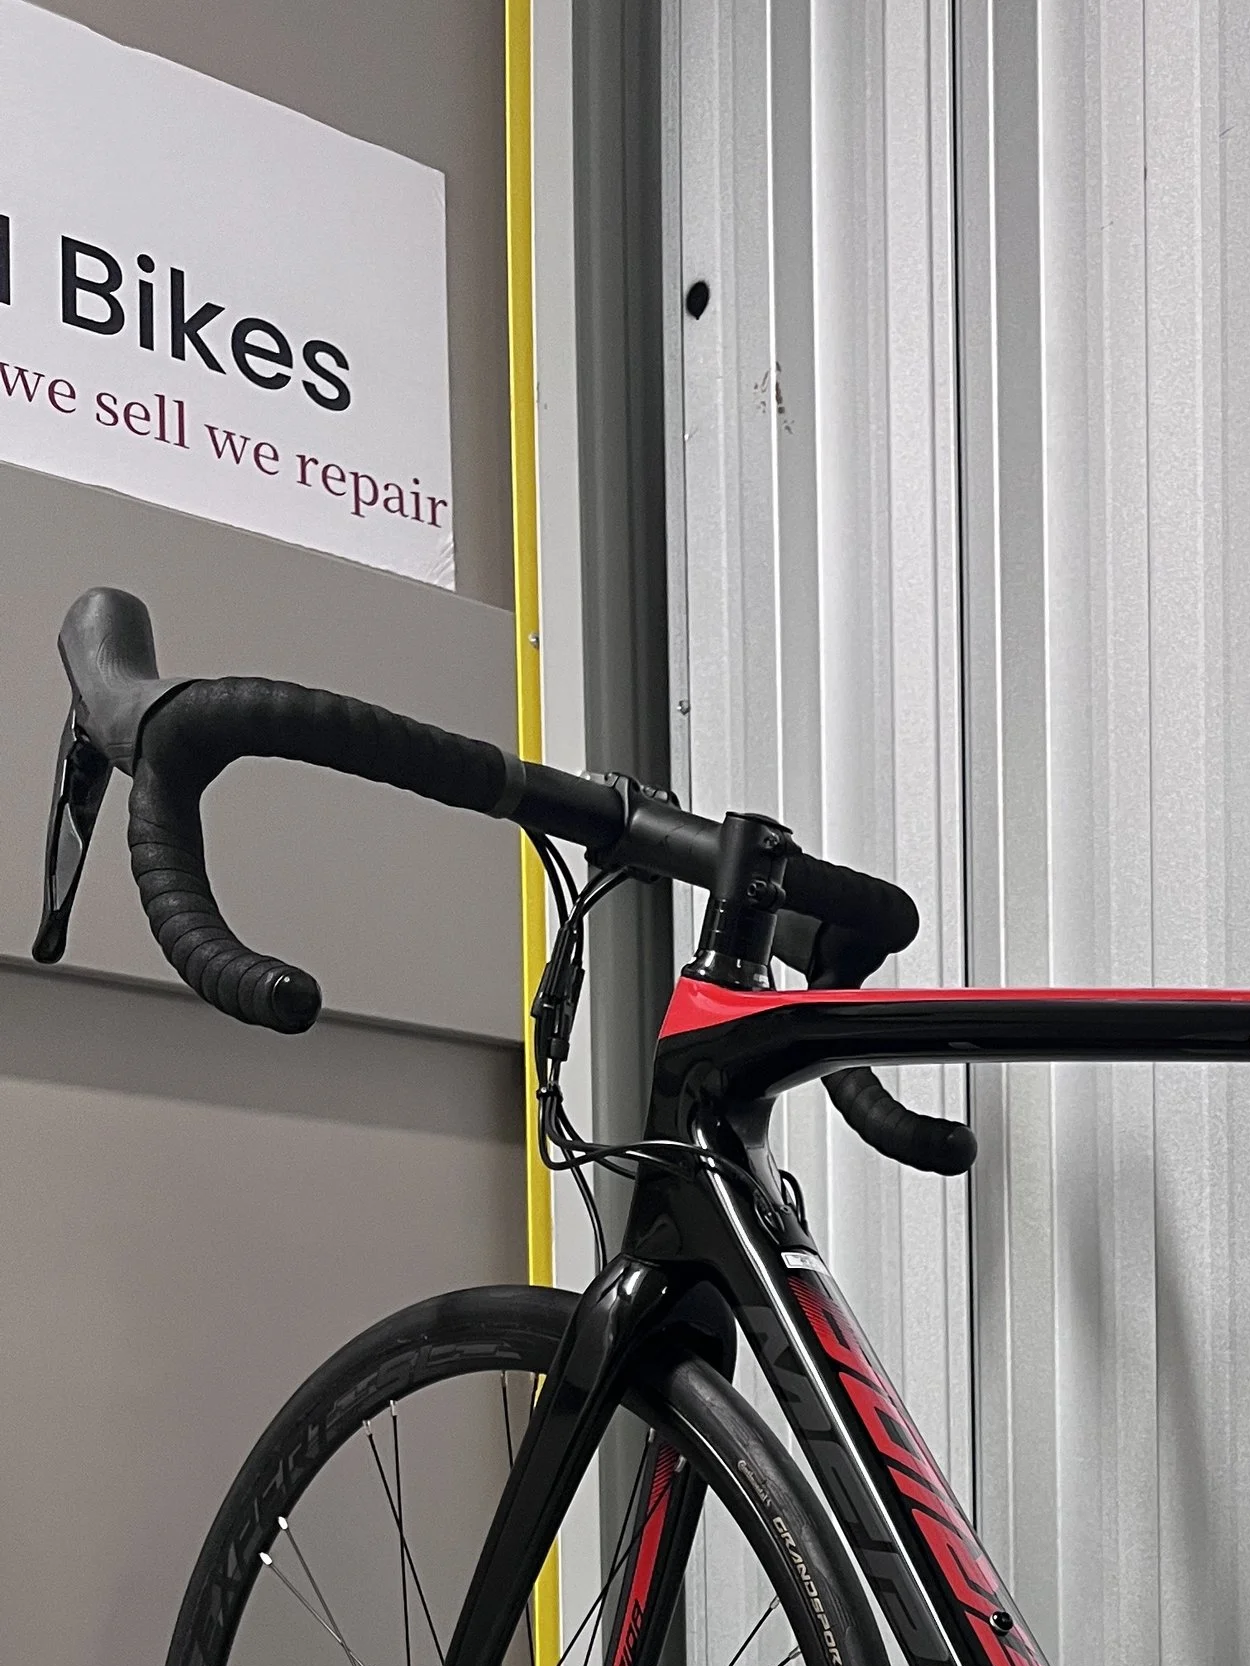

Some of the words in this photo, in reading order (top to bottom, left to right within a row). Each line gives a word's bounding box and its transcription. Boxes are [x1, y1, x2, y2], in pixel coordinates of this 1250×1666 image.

[61, 235, 351, 411] Bikes
[0, 362, 76, 413] we
[96, 392, 190, 449] sell
[204, 424, 279, 475] we
[296, 454, 447, 528] repair
